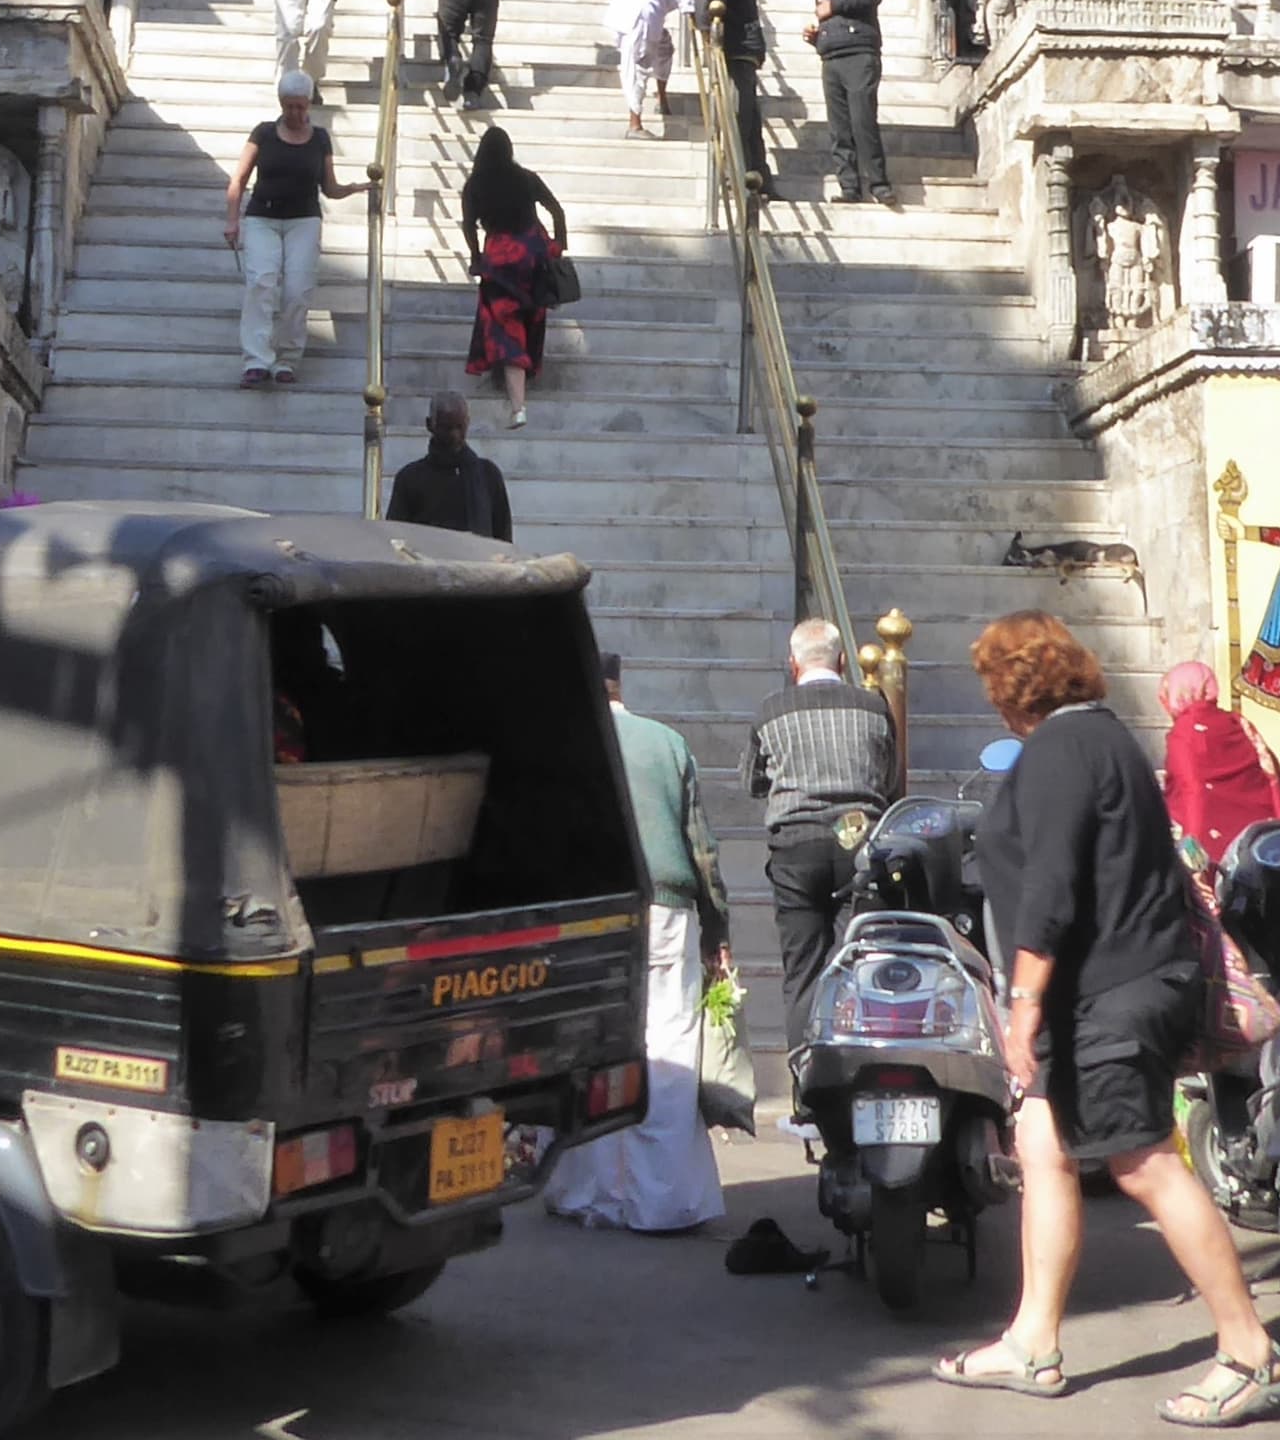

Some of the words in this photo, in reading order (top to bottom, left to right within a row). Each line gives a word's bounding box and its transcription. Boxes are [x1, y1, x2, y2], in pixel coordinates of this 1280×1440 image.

[432, 960, 548, 1006] PIAGGIO
[64, 1053, 99, 1075] RJ27
[102, 1060, 121, 1078] PA
